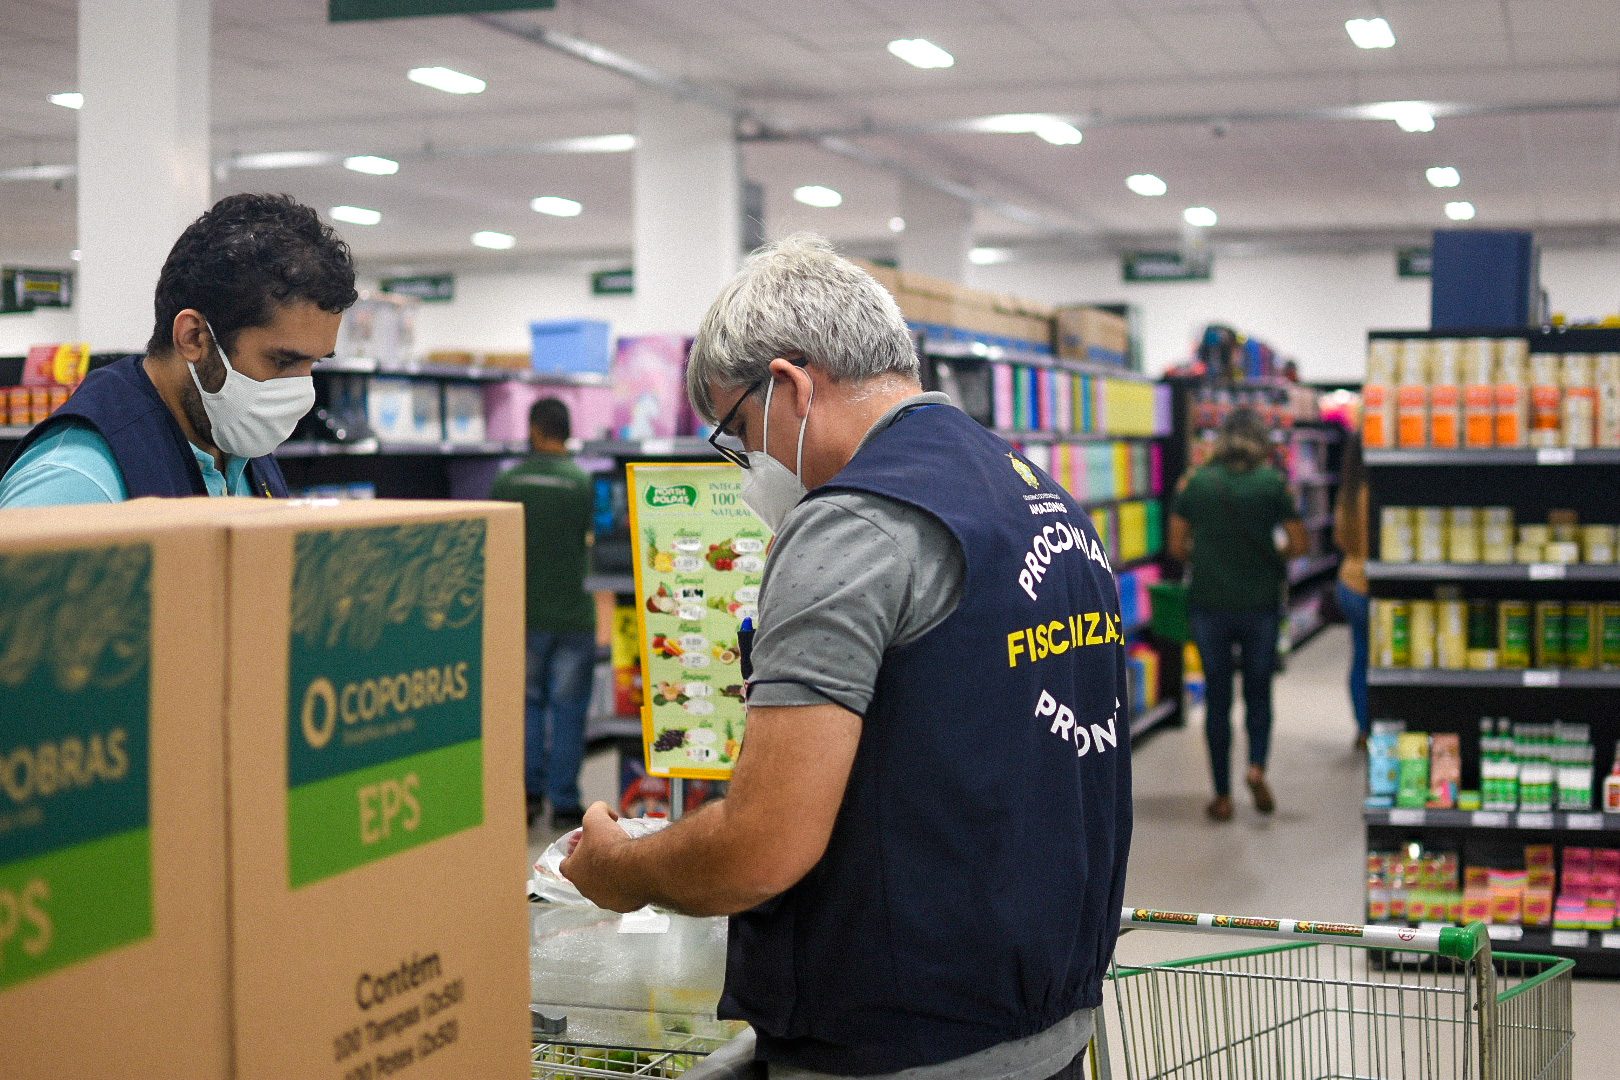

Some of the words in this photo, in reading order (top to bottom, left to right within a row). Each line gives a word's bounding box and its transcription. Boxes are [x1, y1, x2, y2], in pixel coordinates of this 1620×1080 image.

[341, 661, 468, 725] COPOBRAS
[357, 773, 421, 845] EPS
[356, 952, 442, 1011] Contém
